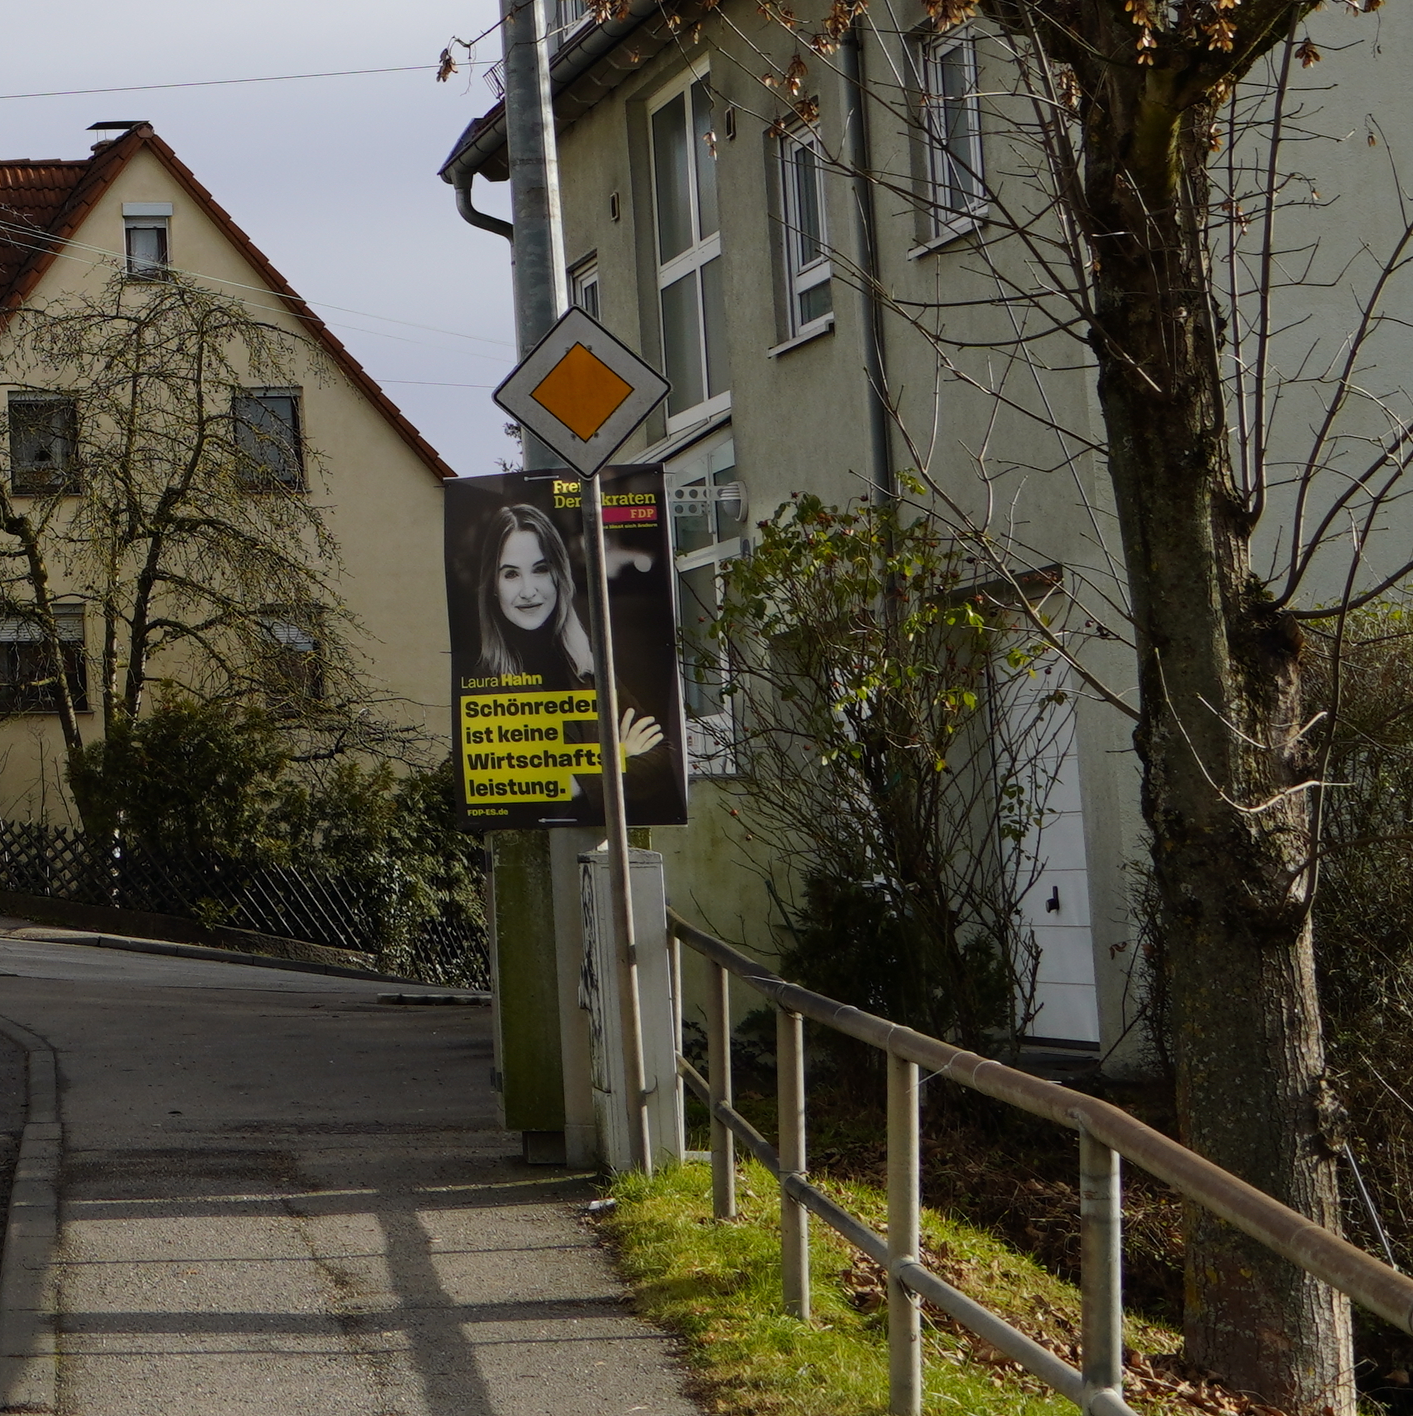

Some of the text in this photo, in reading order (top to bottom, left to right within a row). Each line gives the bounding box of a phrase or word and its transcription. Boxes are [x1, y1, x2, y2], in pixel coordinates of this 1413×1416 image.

[553, 479, 581, 493] Frei
[554, 492, 656, 508] Dekraten
[630, 508, 654, 519] FDP
[461, 673, 542, 688] Laura Hahn
[466, 724, 559, 744] ist keine
[469, 778, 566, 798] leistung.
[467, 808, 508, 816] FDP-ES.de
